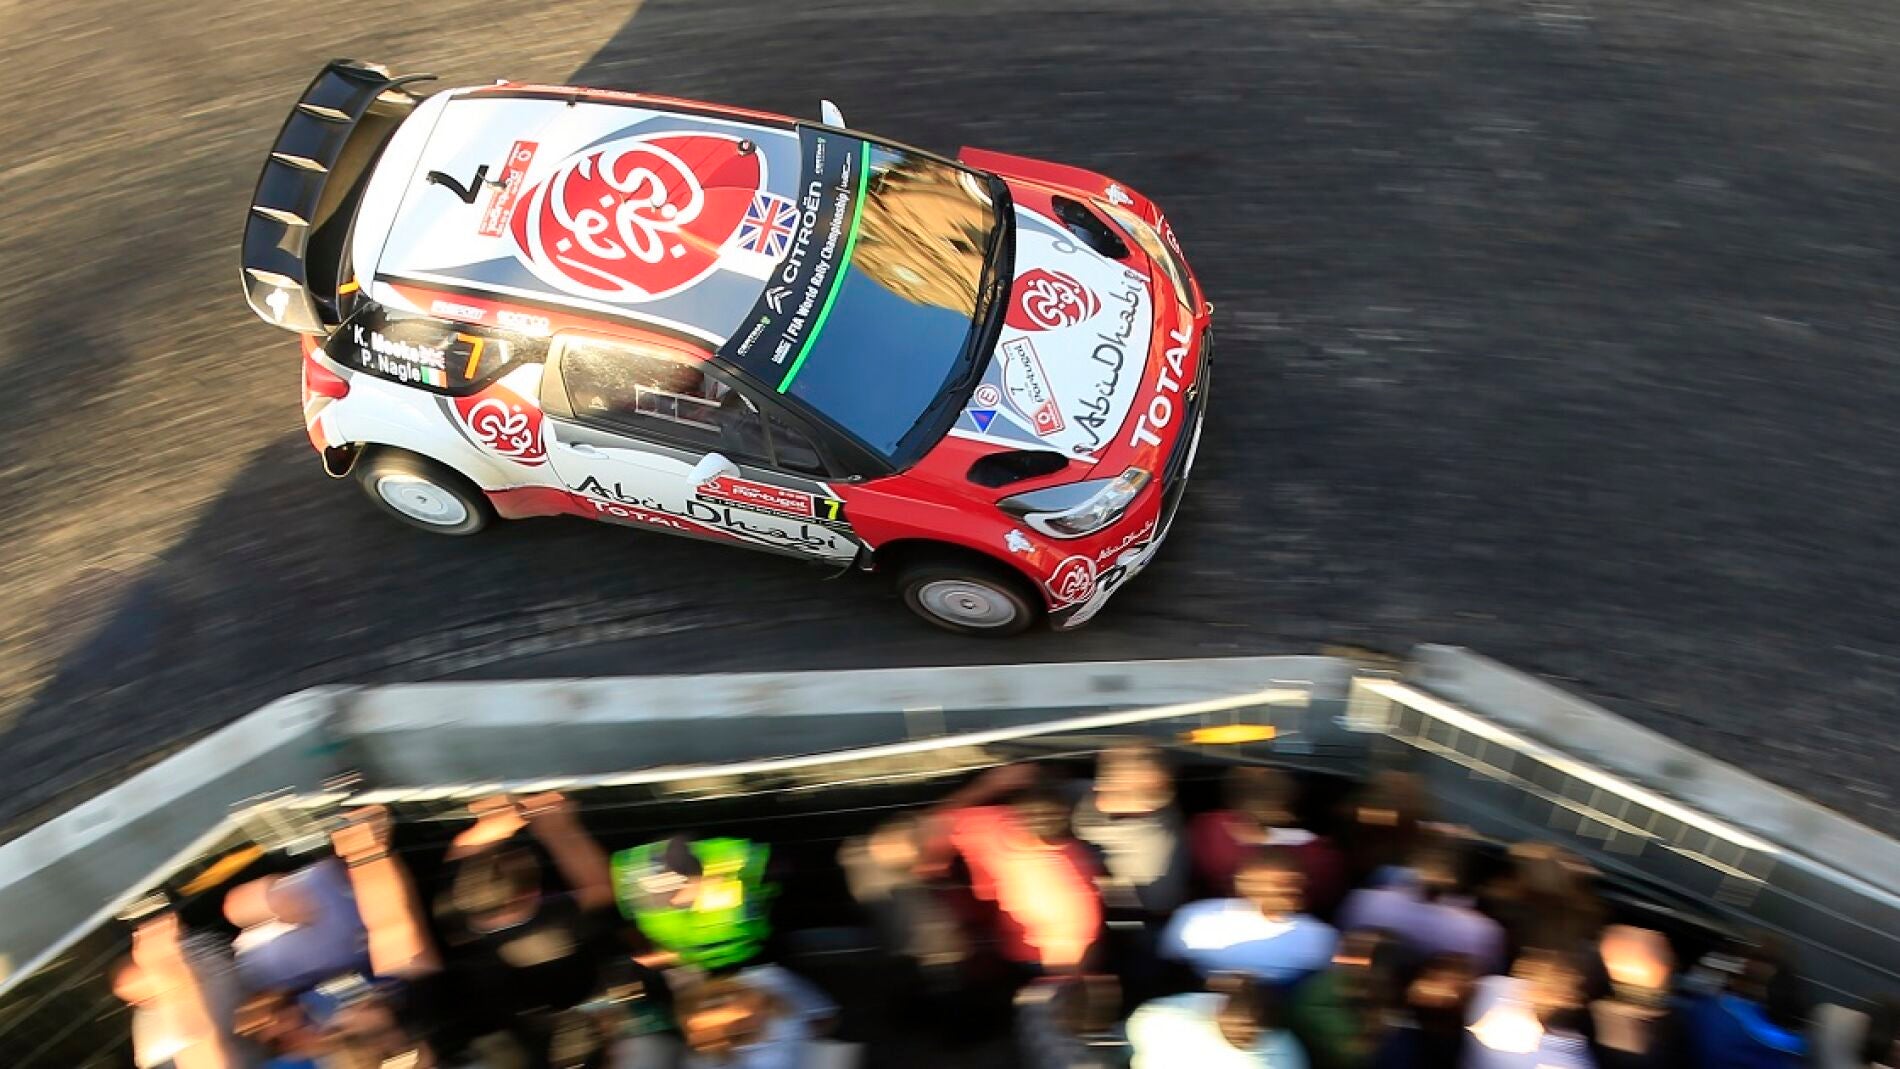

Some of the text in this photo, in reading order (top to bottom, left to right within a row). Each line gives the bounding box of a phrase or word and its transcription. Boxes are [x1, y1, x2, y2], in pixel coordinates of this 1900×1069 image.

[787, 315, 805, 338] FIA
[797, 285, 820, 316] World
[810, 259, 831, 289] Rally
[821, 190, 850, 260] Championship
[354, 324, 369, 347] K.
[362, 349, 421, 383] P. Nagle
[457, 332, 484, 380] 7
[1130, 325, 1192, 448] TOTAL
[587, 498, 690, 530] TOTAL
[733, 488, 806, 508] Portugal
[823, 500, 840, 520] 7
